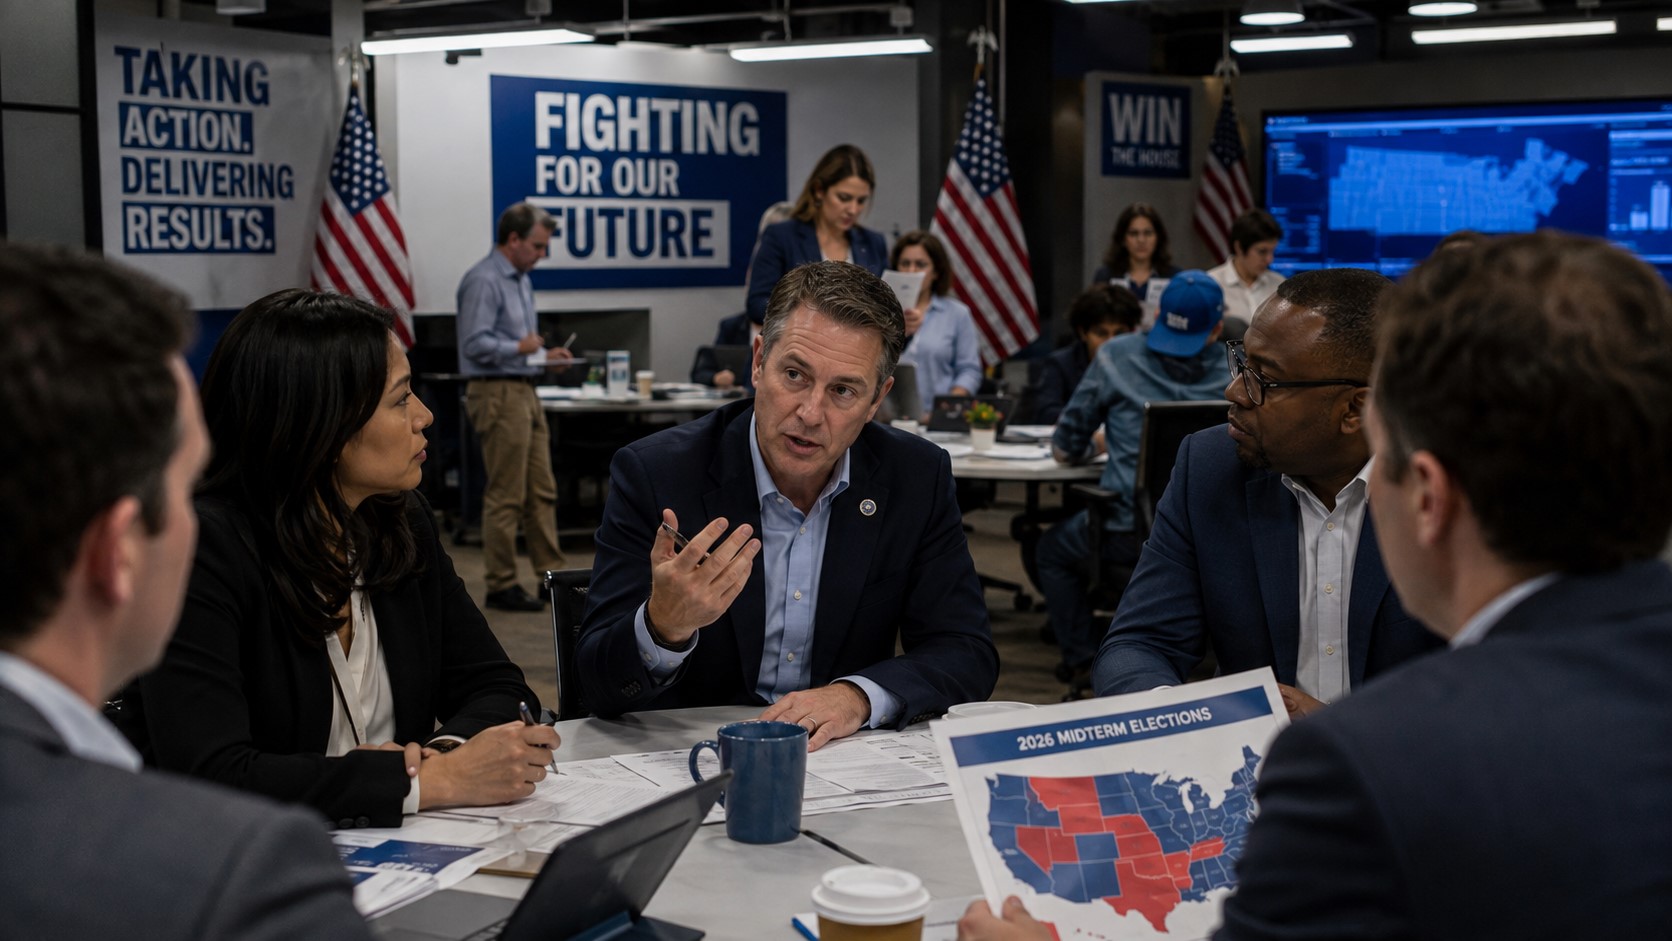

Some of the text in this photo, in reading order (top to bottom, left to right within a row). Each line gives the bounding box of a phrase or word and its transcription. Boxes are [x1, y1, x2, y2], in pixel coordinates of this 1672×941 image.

[114, 45, 269, 106] TAKING
[123, 106, 250, 152] ACTION.
[535, 91, 760, 156] FIGHTING
[1109, 93, 1181, 146] WIN
[121, 156, 294, 200] DELIVERING
[535, 155, 680, 197] FOR OUR
[126, 205, 272, 250] RESULTS.
[1017, 707, 1213, 751] 2026 MIDTERM ELECTIONS
